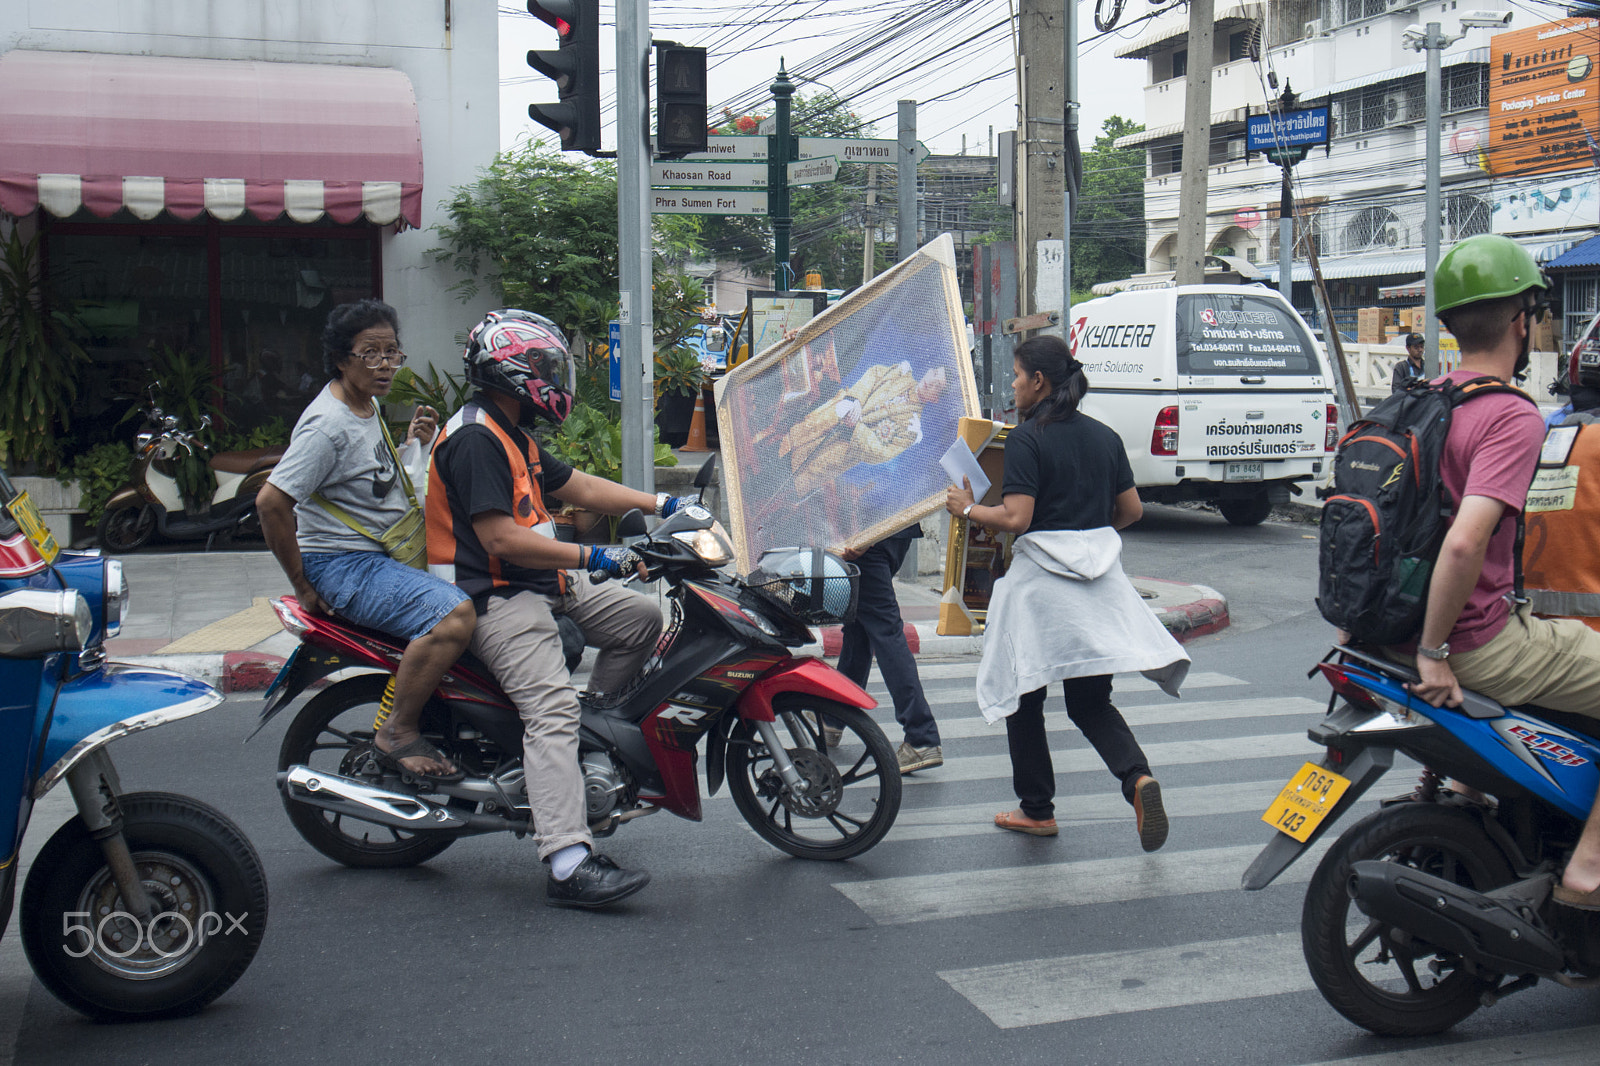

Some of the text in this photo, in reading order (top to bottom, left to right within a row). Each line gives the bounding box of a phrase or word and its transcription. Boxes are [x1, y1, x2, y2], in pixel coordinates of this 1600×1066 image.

[1501, 87, 1587, 112] Packaging Service Center
[1250, 111, 1326, 136] ถนนประชาธิปไตย
[844, 146, 889, 160] ภูเขาทอง
[662, 169, 731, 180] Khaosan Road
[655, 197, 736, 209] Phra Sumen Fort
[1215, 310, 1278, 325] KYOCERA
[1080, 324, 1156, 349] KYOCERA
[1082, 360, 1144, 374] ment Solutions
[1206, 417, 1304, 436] เครื่องถ่ายเอกสาร
[1206, 438, 1297, 457] เลเซอร์ปริ้นเตอร์
[727, 670, 755, 679] SUZUKI
[1277, 808, 1306, 833] 143
